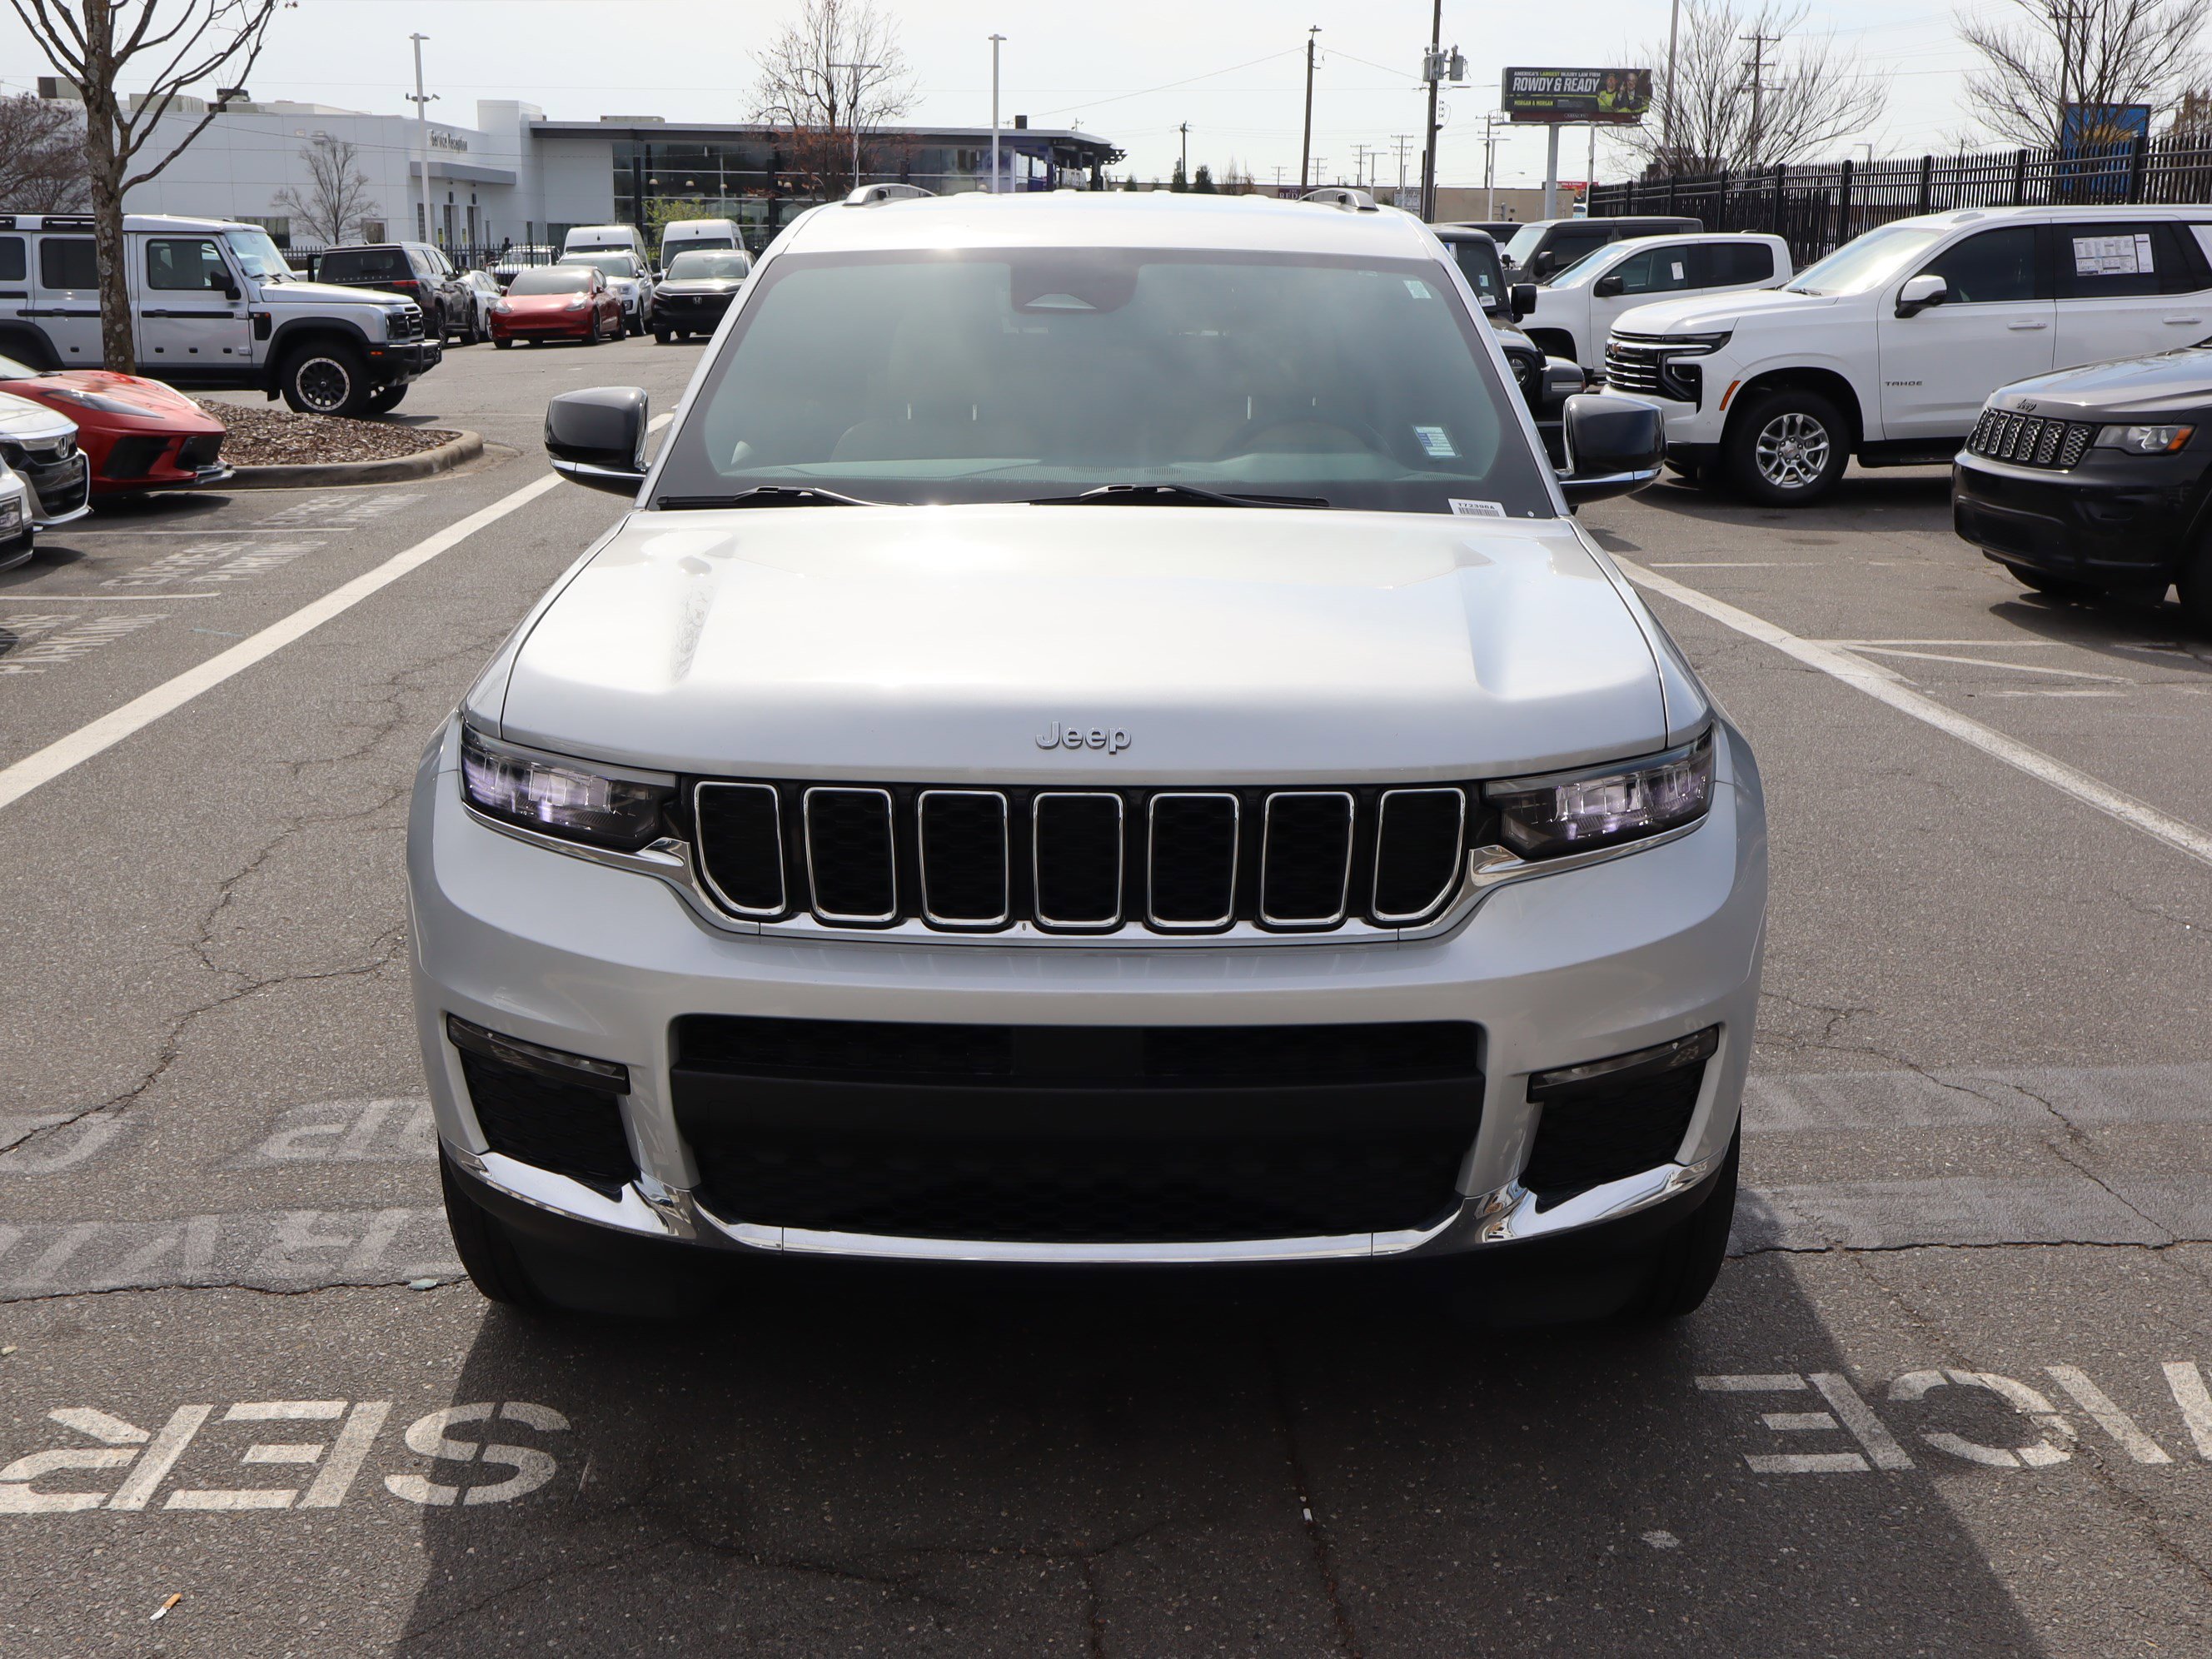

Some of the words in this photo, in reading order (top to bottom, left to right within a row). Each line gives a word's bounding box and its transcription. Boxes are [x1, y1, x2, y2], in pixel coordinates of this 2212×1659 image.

[1512, 77, 1554, 92] ROWDY
[1554, 78, 1562, 92] &
[1563, 77, 1600, 92] READY
[2016, 398, 2037, 413] Jeep
[187, 541, 329, 584] PARKING
[1035, 720, 1132, 755] Jeep
